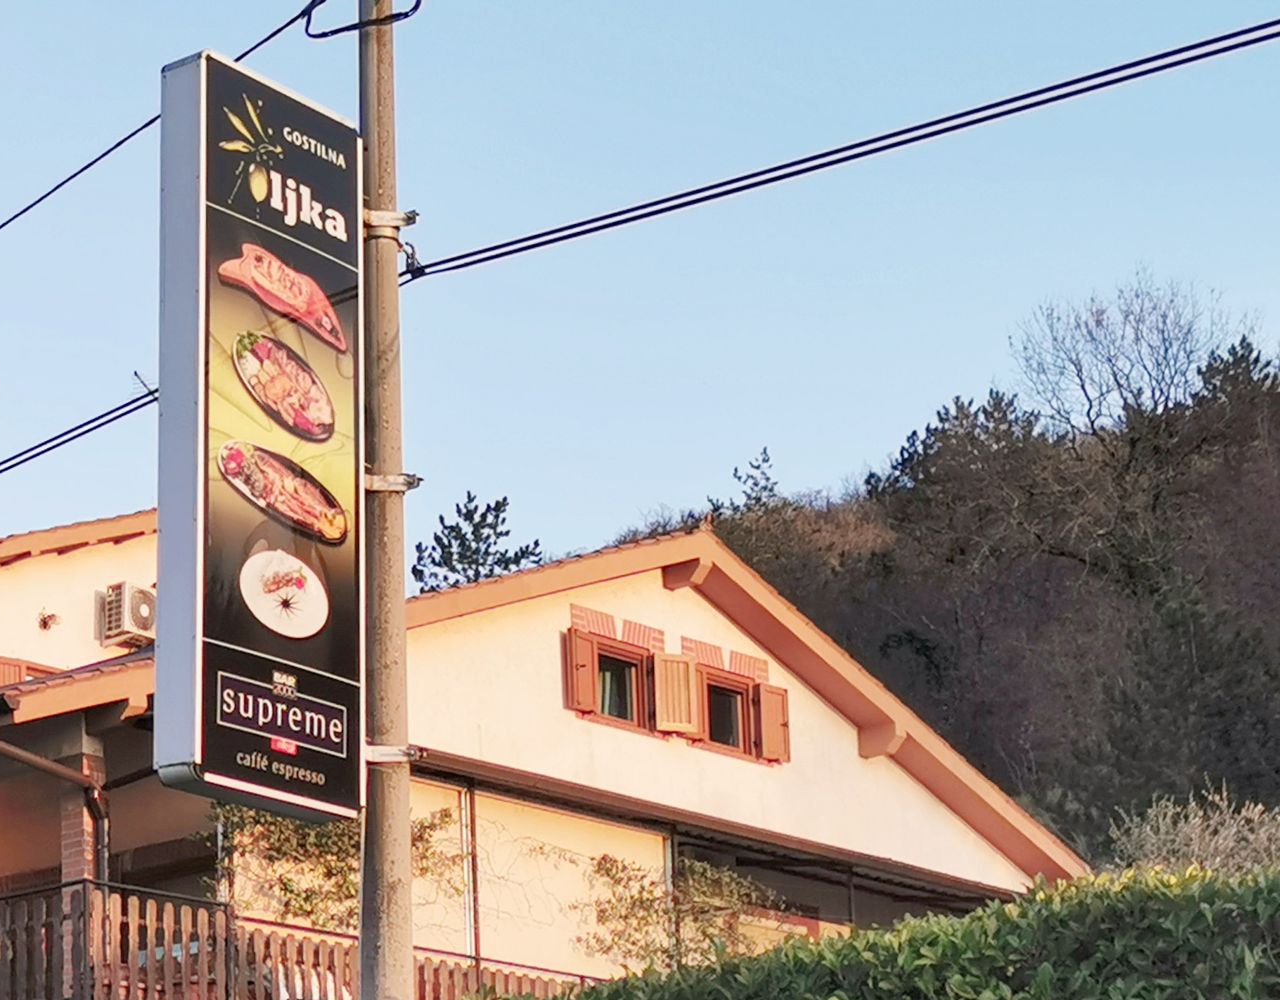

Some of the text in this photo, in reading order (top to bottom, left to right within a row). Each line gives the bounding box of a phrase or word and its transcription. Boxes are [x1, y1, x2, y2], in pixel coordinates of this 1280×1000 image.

[283, 126, 347, 170] GOSTILNA
[222, 688, 343, 743] supreme
[236, 750, 326, 786] caffé espresso
